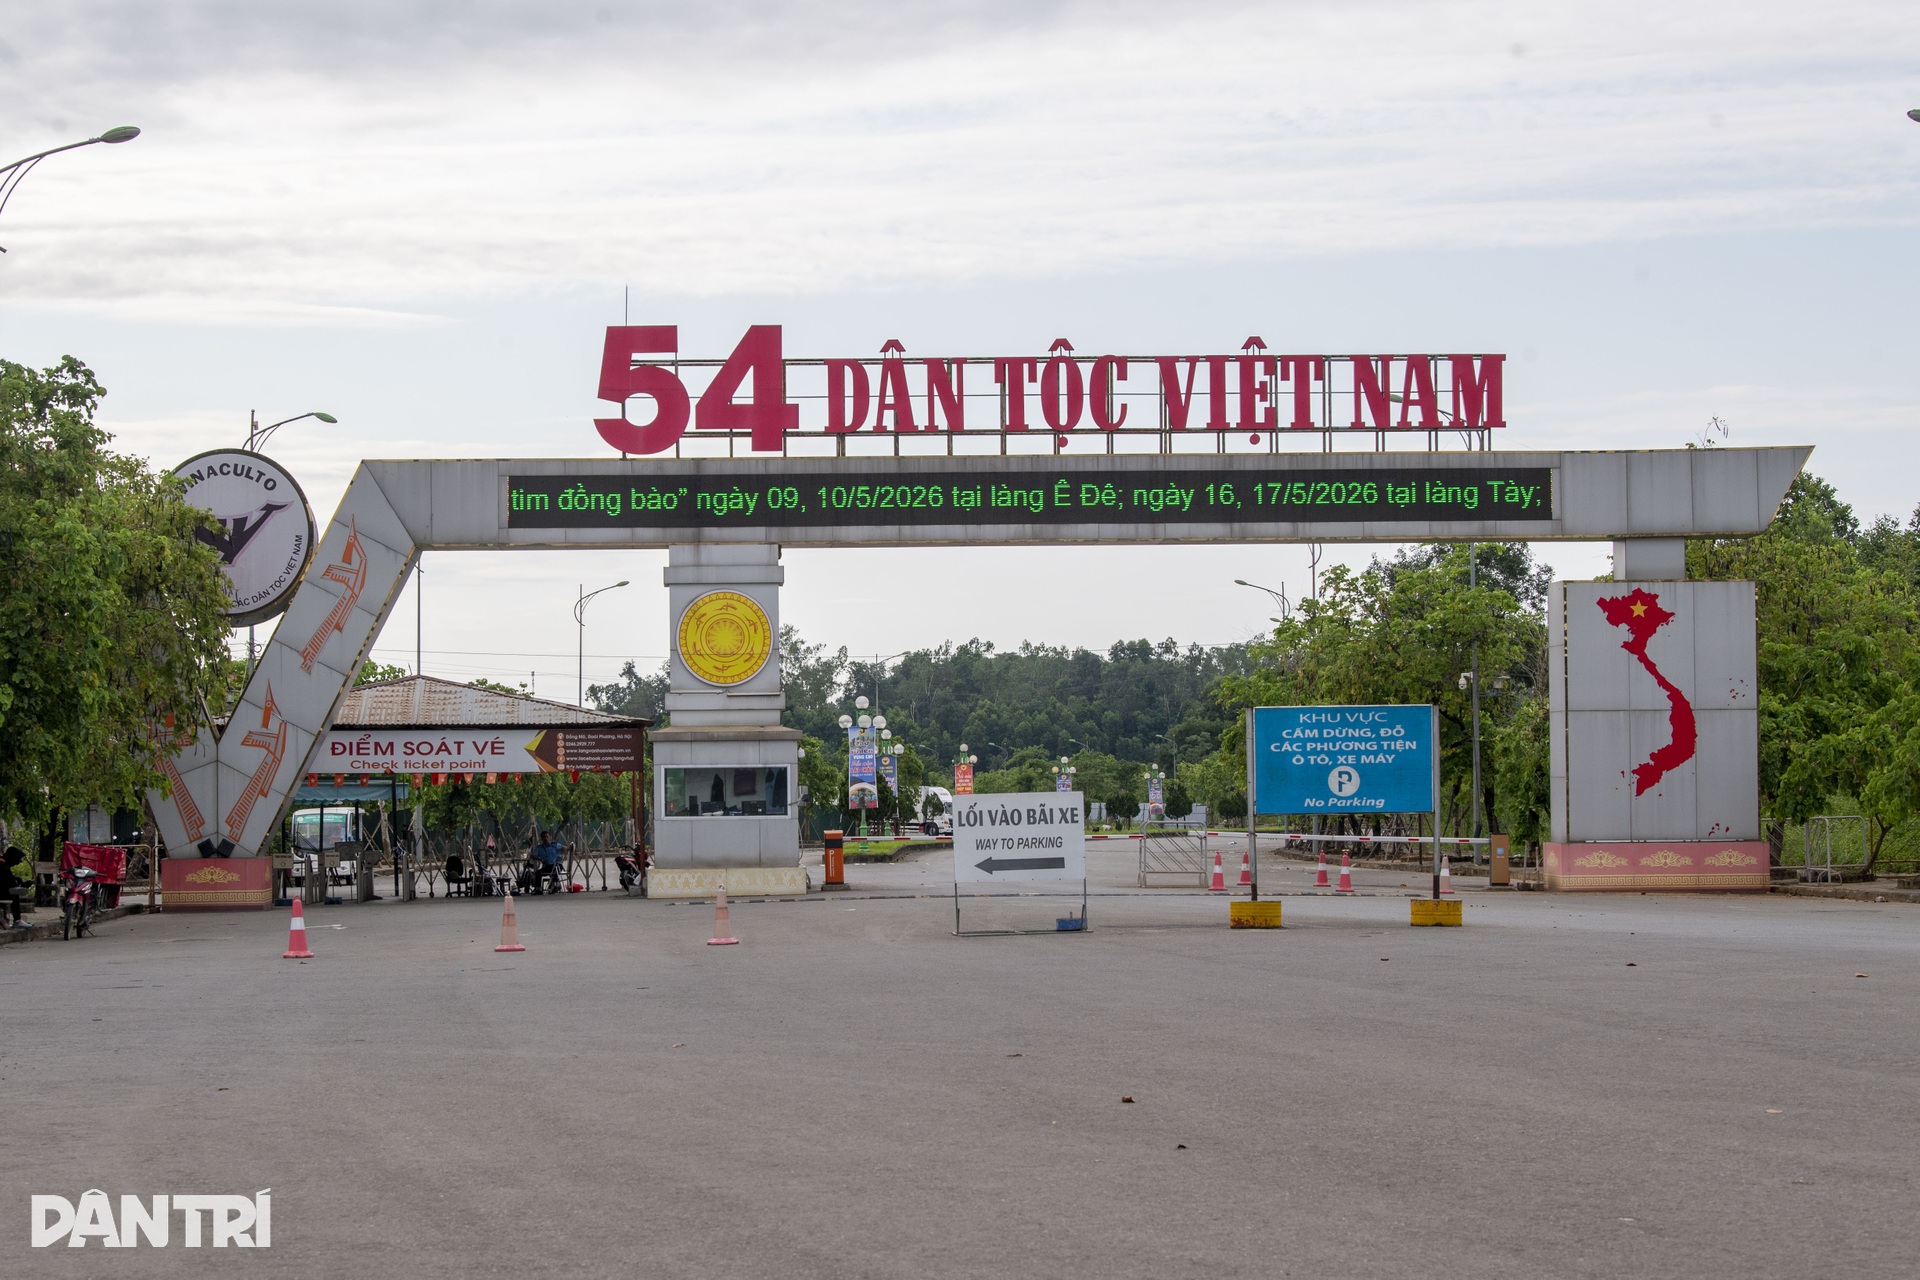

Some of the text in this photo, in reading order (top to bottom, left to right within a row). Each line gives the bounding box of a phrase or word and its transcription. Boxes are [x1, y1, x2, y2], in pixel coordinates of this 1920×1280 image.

[593, 325, 1507, 455] 54 DÂN TỘC VIỆT NAM
[174, 463, 277, 495] NACULTO
[558, 483, 621, 516] đồng
[697, 486, 758, 516] ngày
[768, 487, 806, 512] 09,
[818, 485, 944, 508] 10/5/2026
[952, 485, 981, 511] tại
[991, 484, 1044, 512] làng
[1054, 479, 1071, 506] Ê
[1080, 483, 1123, 510] Đê;
[1134, 482, 1194, 512] ngày
[1206, 483, 1241, 508] 16,
[1254, 482, 1378, 504] 17/5/2026
[1386, 482, 1416, 508] tại
[1425, 480, 1478, 509] làng
[1488, 480, 1540, 509] Tày;
[251, 591, 271, 604] DÂN
[292, 534, 303, 556] NAM
[1300, 711, 1387, 725] KHU VỰC
[1282, 725, 1405, 739] CẤM DỪNG, ĐỖ
[330, 734, 505, 756] ĐIỂM SOÁT VÉ
[1270, 740, 1417, 752] CÁC PHƯƠNG TIỆN
[350, 759, 486, 770] Check ticket point
[1292, 753, 1395, 765] Ô TÔ, XE MÁY
[1305, 797, 1385, 808] No Parking
[958, 802, 1079, 827] LỐI VÀO BÃI XE
[975, 836, 1063, 850] WAY TO PARKING
